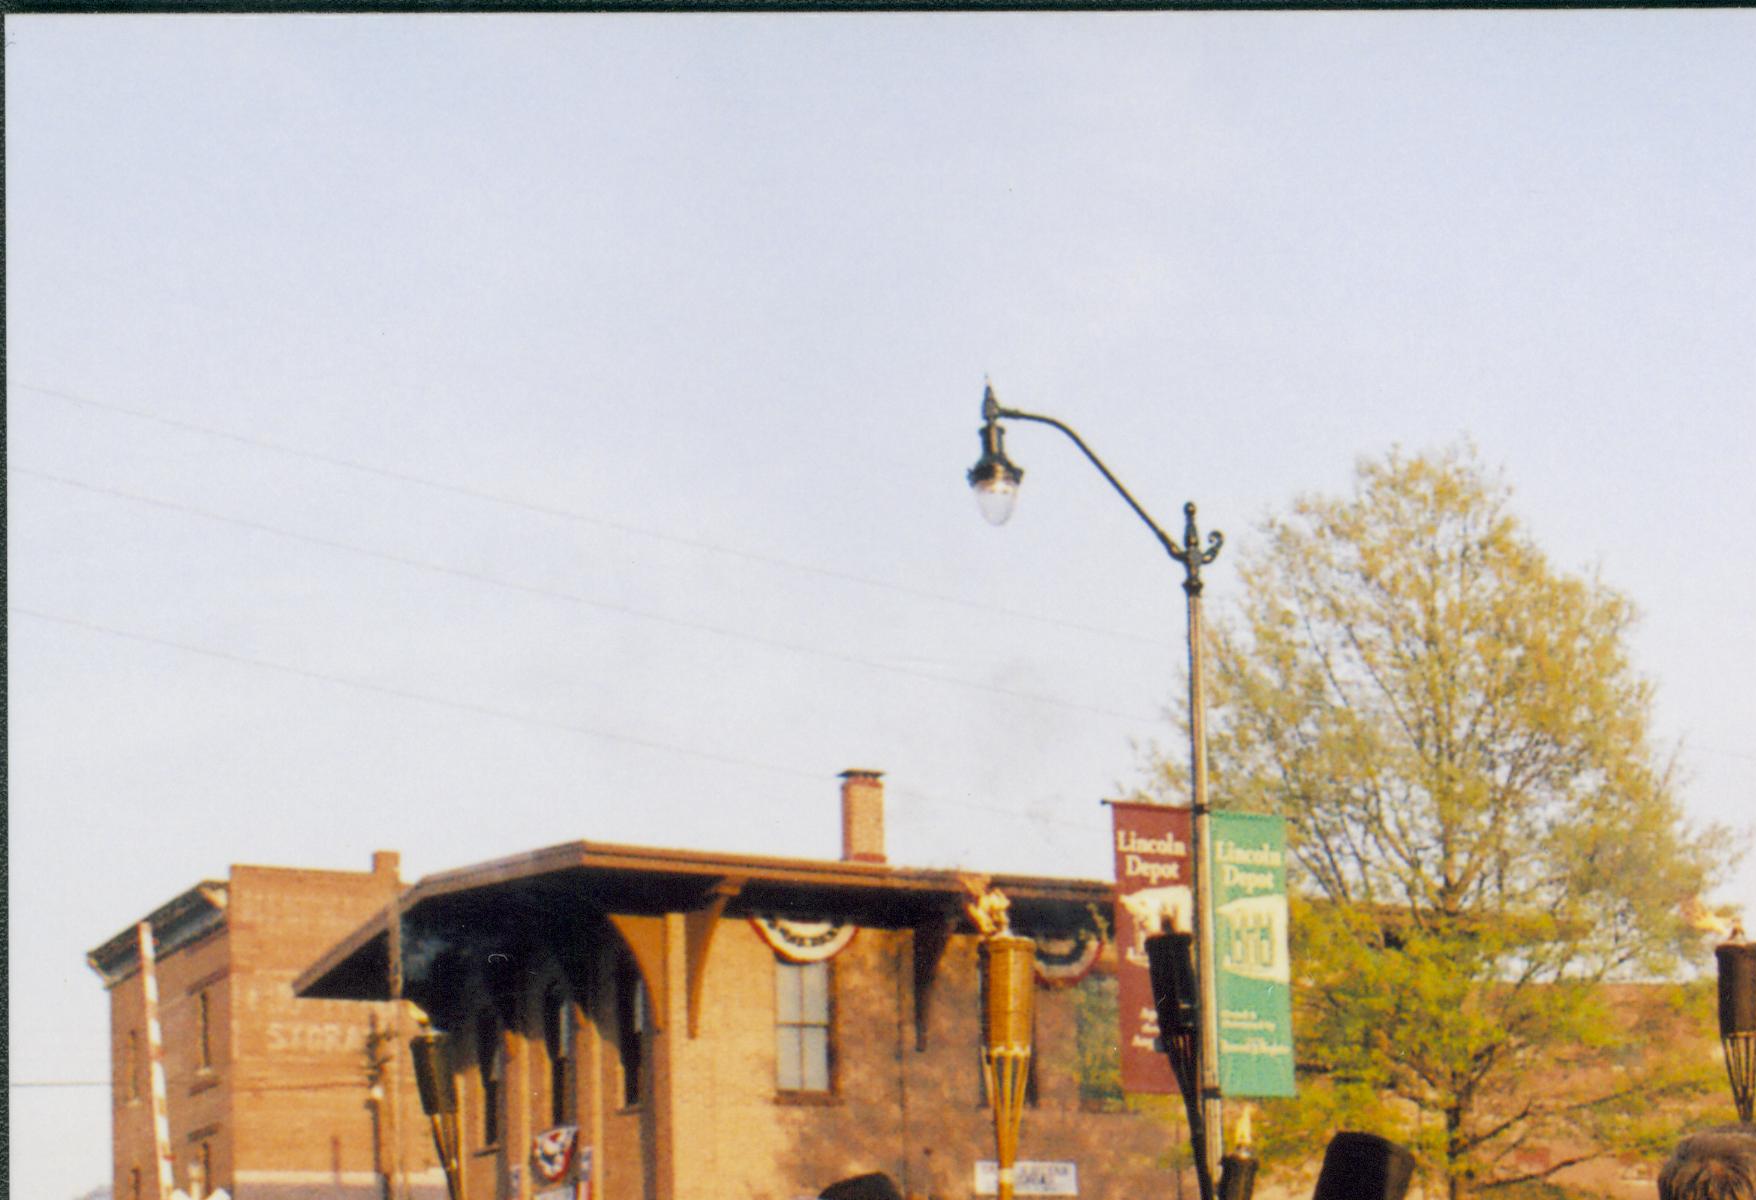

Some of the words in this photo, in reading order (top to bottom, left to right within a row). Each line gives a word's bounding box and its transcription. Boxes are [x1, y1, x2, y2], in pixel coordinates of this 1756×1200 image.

[1117, 830, 1187, 857] Lincoln
[1214, 839, 1282, 867] Lincoln
[1124, 853, 1181, 885] Depot
[1222, 864, 1275, 895] Depot
